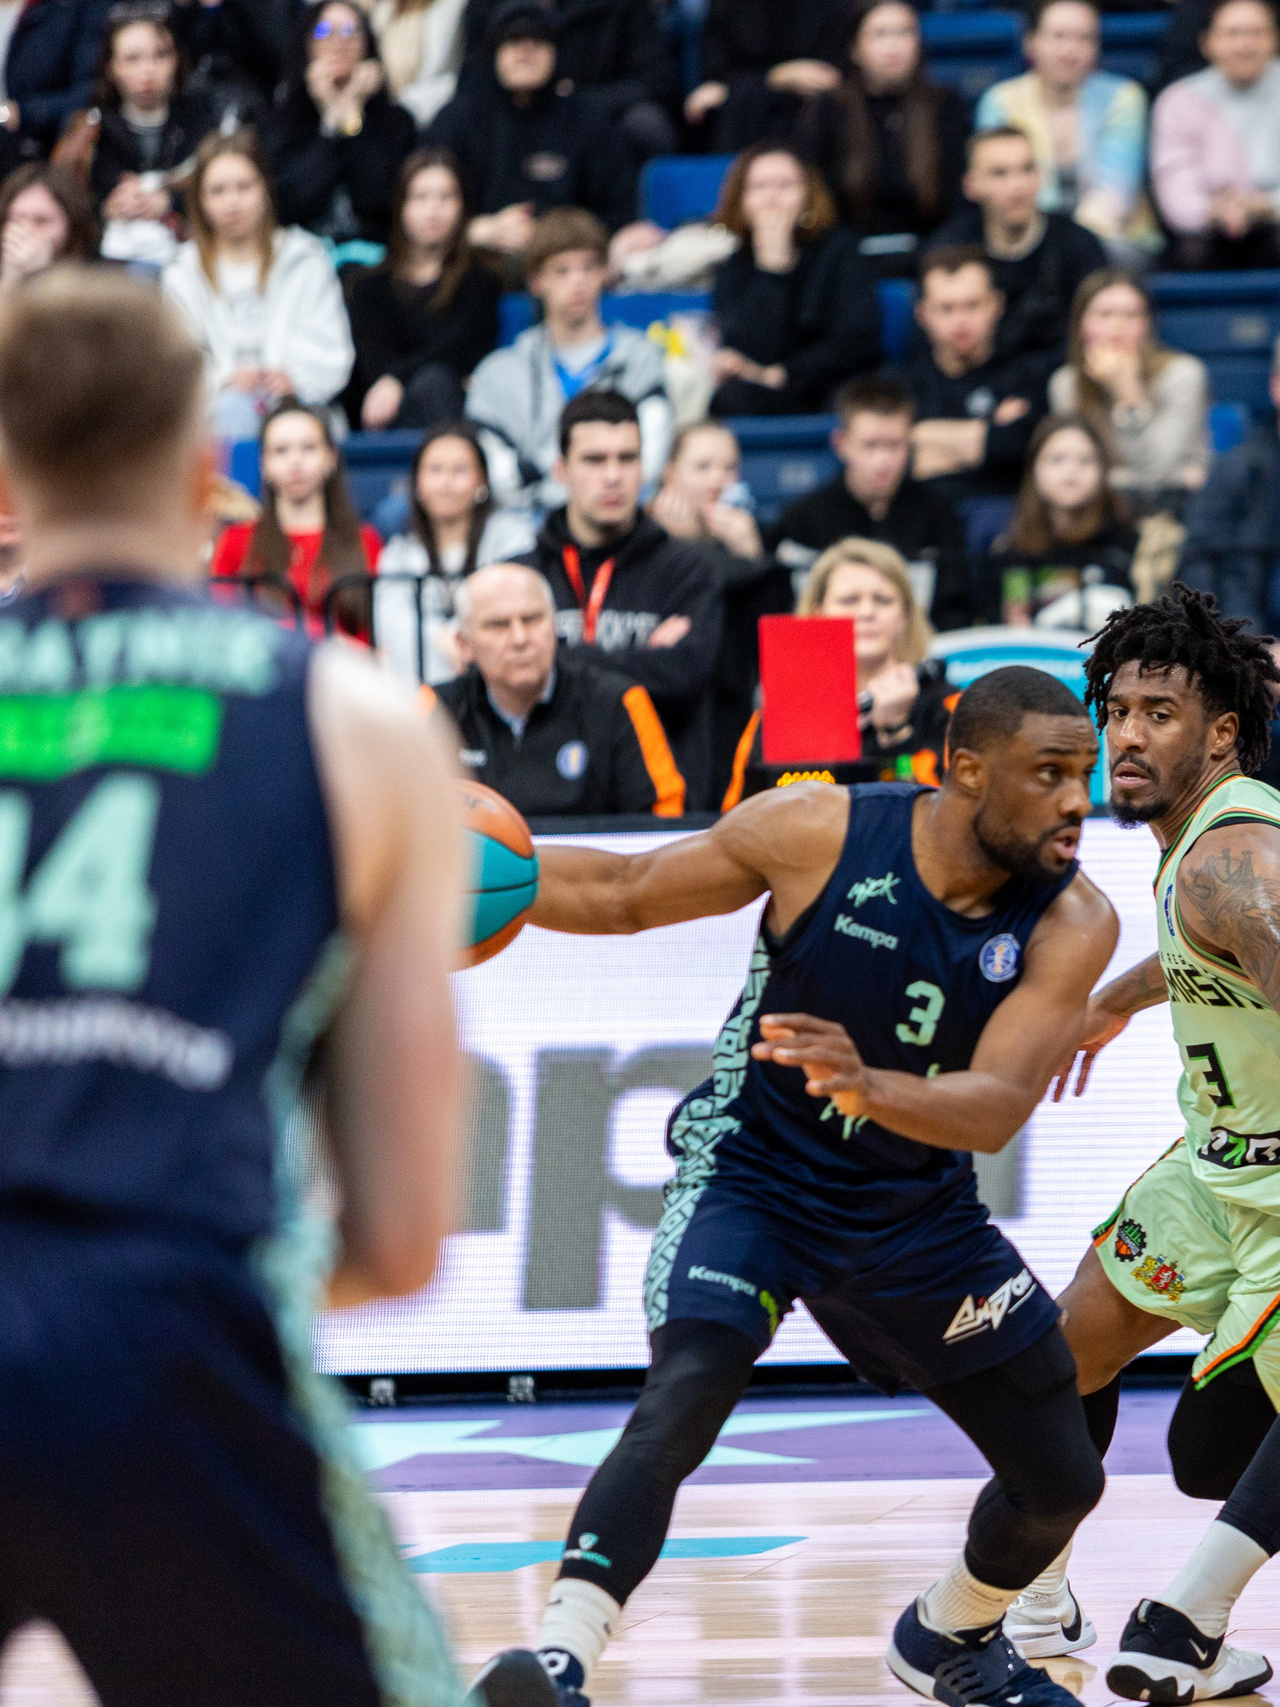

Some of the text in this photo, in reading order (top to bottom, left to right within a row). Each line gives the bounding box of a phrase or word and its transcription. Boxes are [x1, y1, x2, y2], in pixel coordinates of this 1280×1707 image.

[834, 913, 900, 951] Kempa
[895, 980, 945, 1047] 3
[1185, 1042, 1237, 1109] 3
[687, 1264, 757, 1297] Kempa
